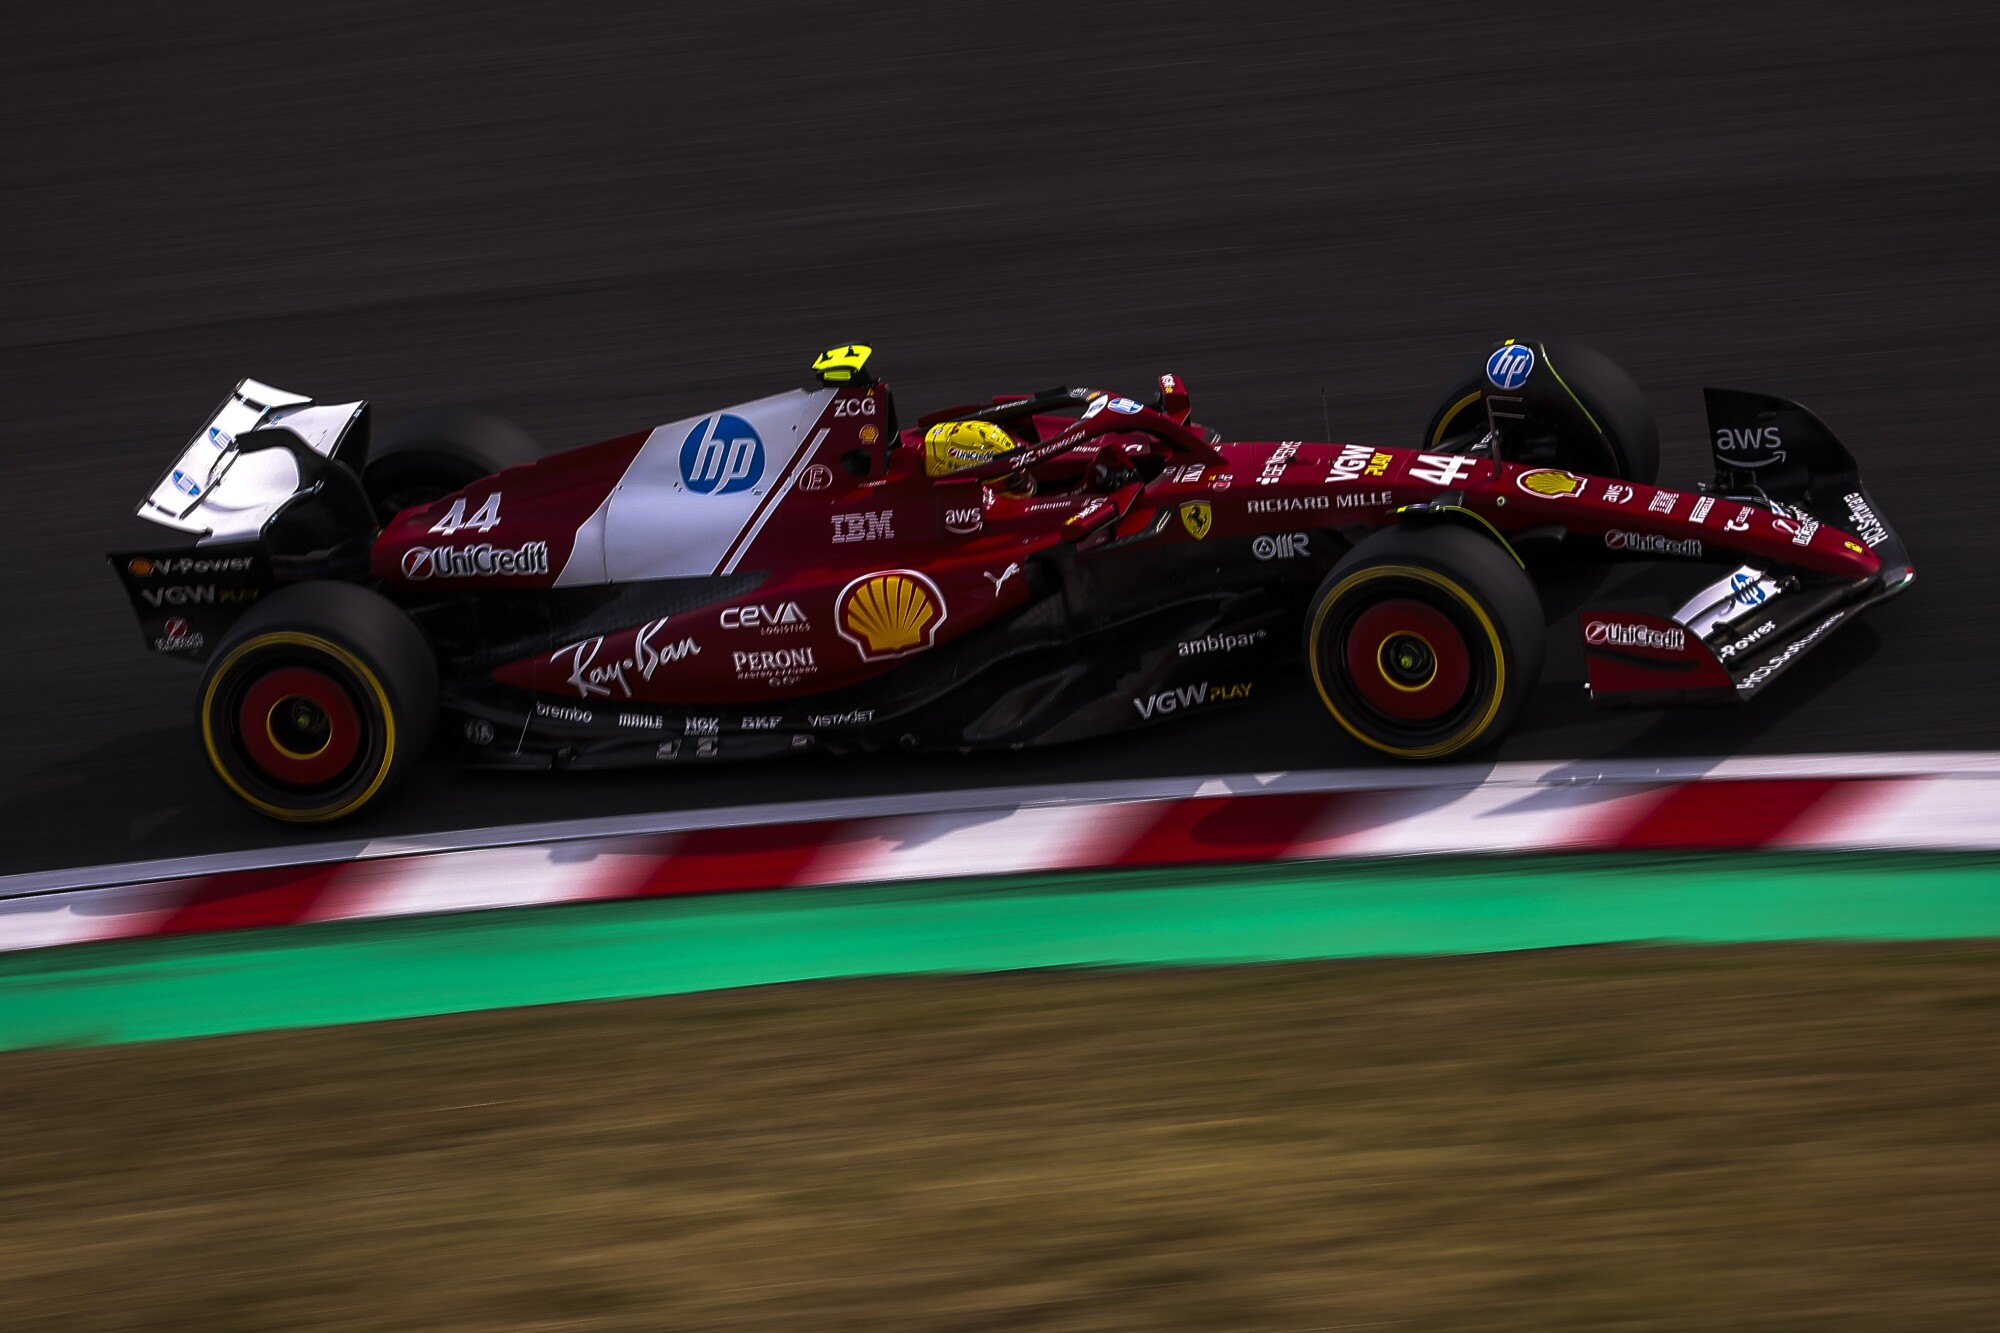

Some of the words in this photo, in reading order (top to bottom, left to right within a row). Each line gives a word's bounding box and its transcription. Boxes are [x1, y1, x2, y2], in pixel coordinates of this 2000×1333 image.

[1493, 345, 1529, 388] hp
[833, 398, 876, 418] ZCG
[1717, 426, 1783, 450] aws
[688, 412, 757, 496] hp
[1324, 444, 1376, 483] VGW
[1408, 455, 1478, 486] 44
[427, 491, 502, 536] 44
[945, 507, 982, 526] aws
[1247, 495, 1330, 514] RICHARD
[1337, 490, 1393, 509] MILLE
[831, 510, 895, 543] IBM
[431, 540, 550, 578] UniCredit
[1625, 531, 1702, 557] UniCredit
[1606, 622, 1685, 651] UniCredit
[732, 646, 816, 673] PERONI
[536, 701, 593, 723] brembo
[1133, 681, 1208, 720] VGW
[1210, 682, 1253, 702] PLAY
